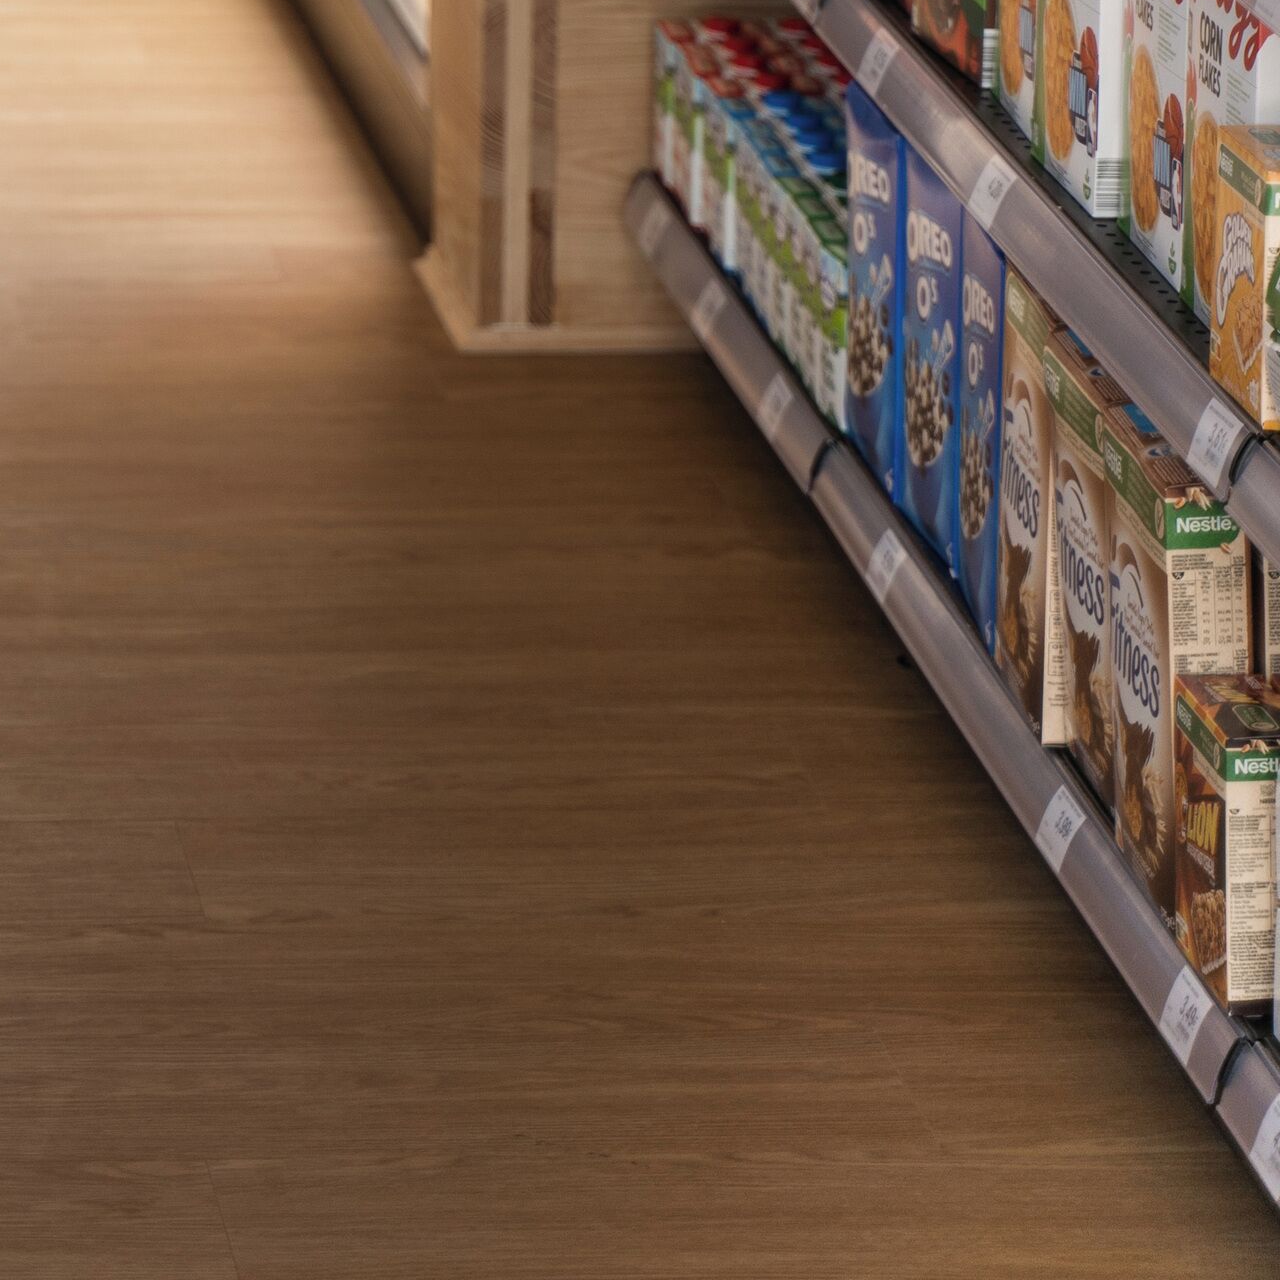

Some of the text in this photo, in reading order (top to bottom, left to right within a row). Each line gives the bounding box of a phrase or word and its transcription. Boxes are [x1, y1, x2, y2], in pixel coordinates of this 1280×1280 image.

[1199, 10, 1223, 66] CORN
[1198, 54, 1221, 98] FLAKES
[907, 209, 953, 268] OREO
[963, 273, 995, 335] OREO
[1176, 515, 1232, 534] Nestlé
[1235, 758, 1280, 776] Nestl
[1178, 995, 1200, 1028] 3,49€
